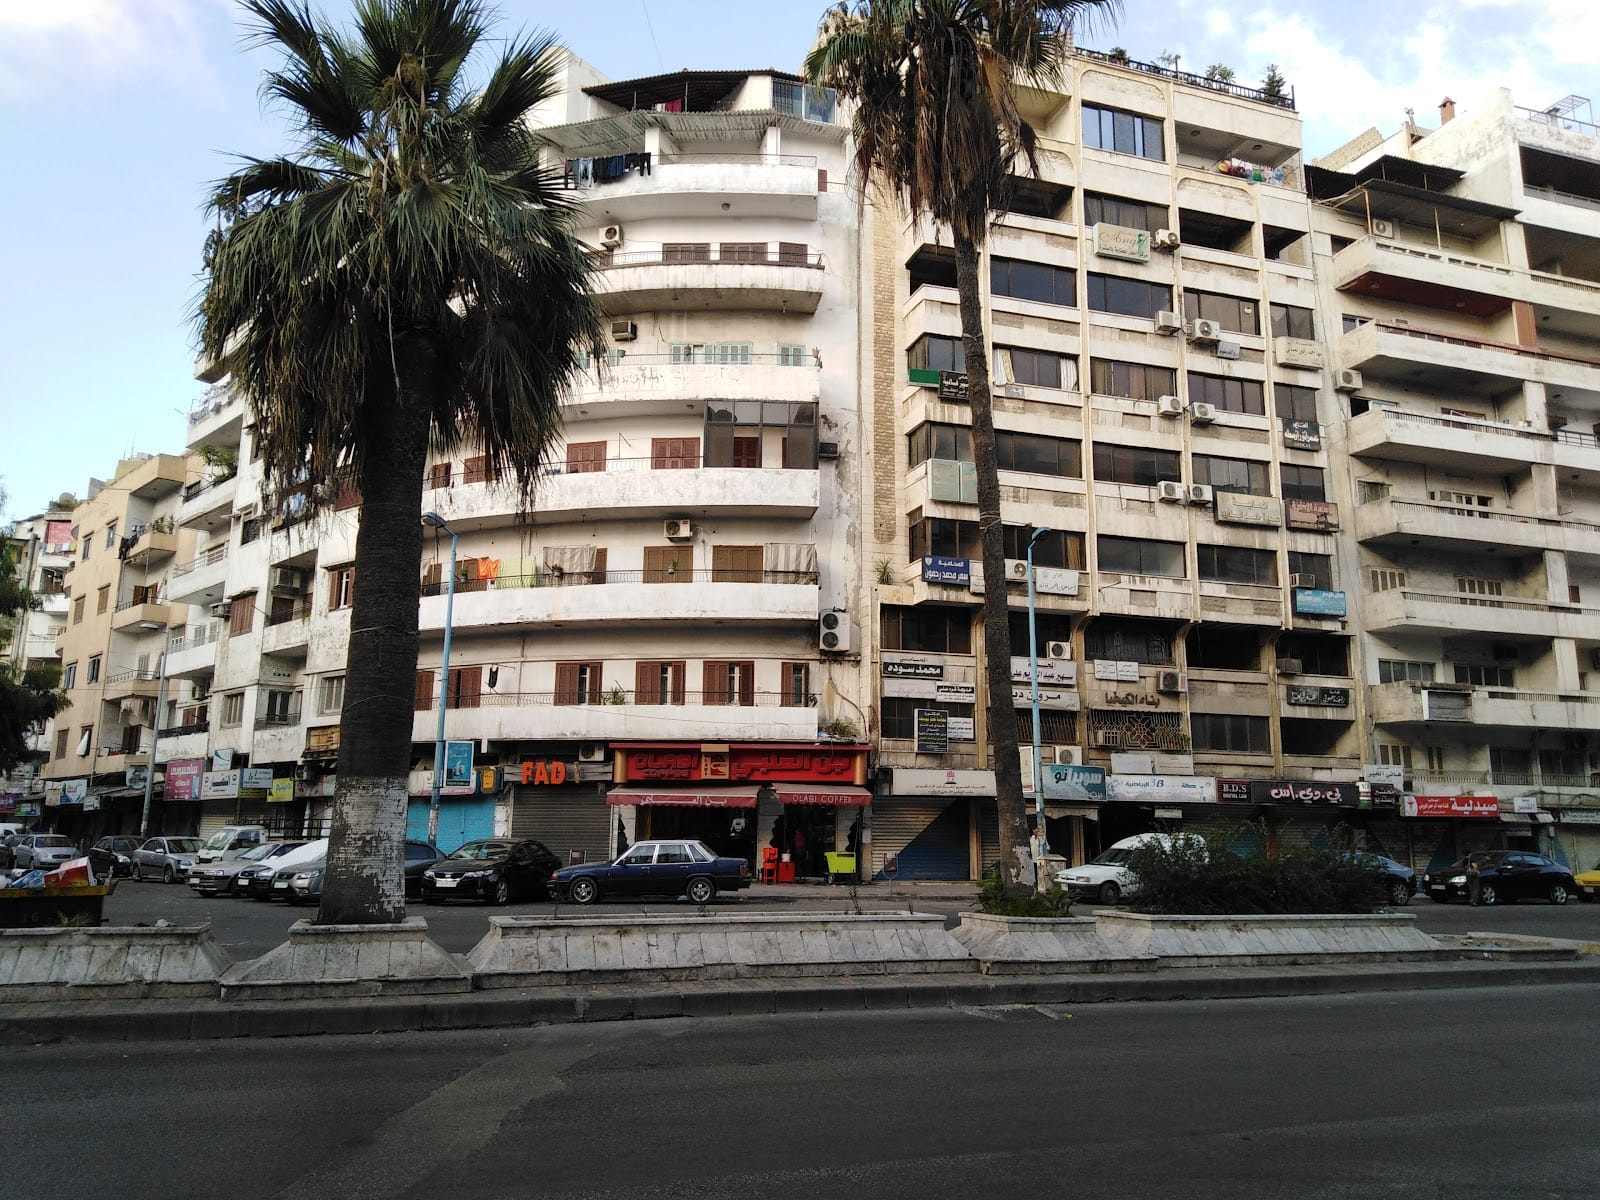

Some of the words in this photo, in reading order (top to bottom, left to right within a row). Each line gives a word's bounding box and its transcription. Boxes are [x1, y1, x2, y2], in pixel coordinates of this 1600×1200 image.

[942, 571, 957, 579] محمد
[887, 664, 915, 674] سوده
[915, 666, 941, 674] محمد
[1027, 692, 1061, 702] مرون
[632, 753, 699, 769] OLABI
[731, 752, 811, 779] العلبي
[815, 756, 850, 774] بن
[1222, 784, 1247, 793] B.D.S
[704, 796, 727, 806] بن
[792, 794, 817, 803] OLABI
[820, 795, 853, 804] COFFEE
[1449, 797, 1498, 815] صيدلية
